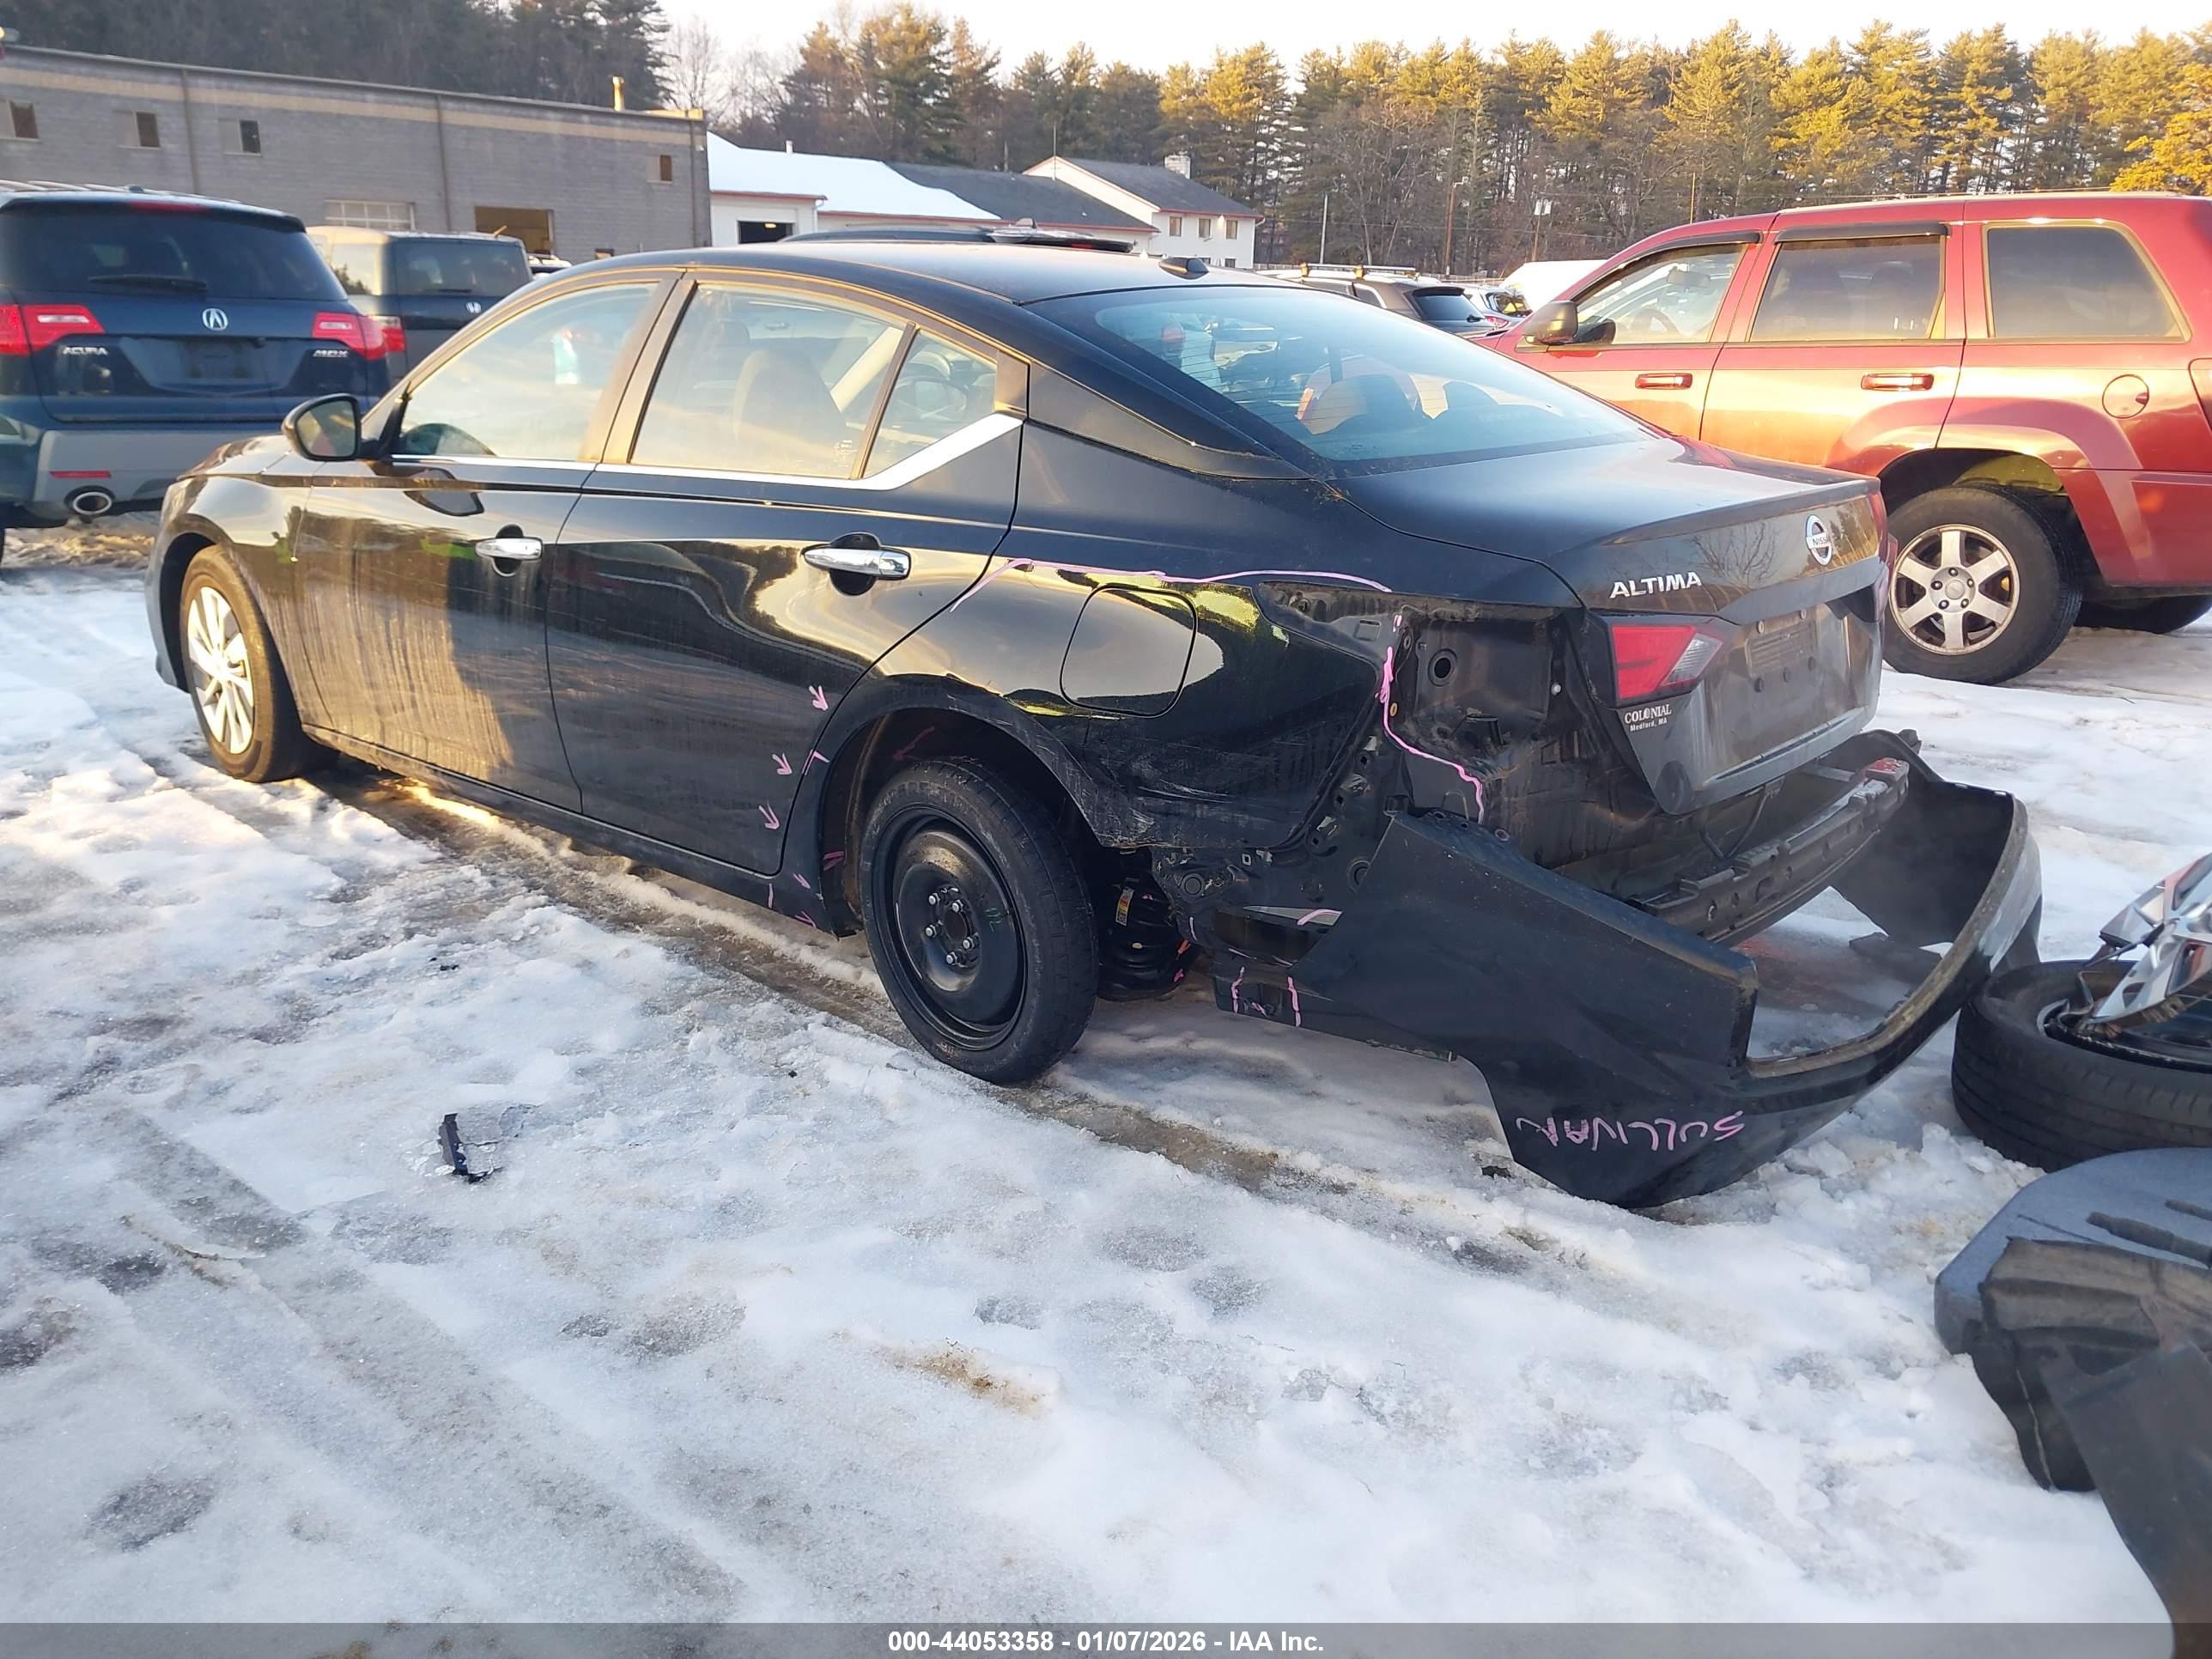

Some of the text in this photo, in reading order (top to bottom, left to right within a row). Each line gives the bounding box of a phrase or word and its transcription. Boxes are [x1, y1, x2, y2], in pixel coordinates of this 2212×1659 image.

[62, 346, 109, 356] ACURA
[1609, 571, 1703, 599] ALTIMA
[1624, 703, 1673, 724] COLONIAL
